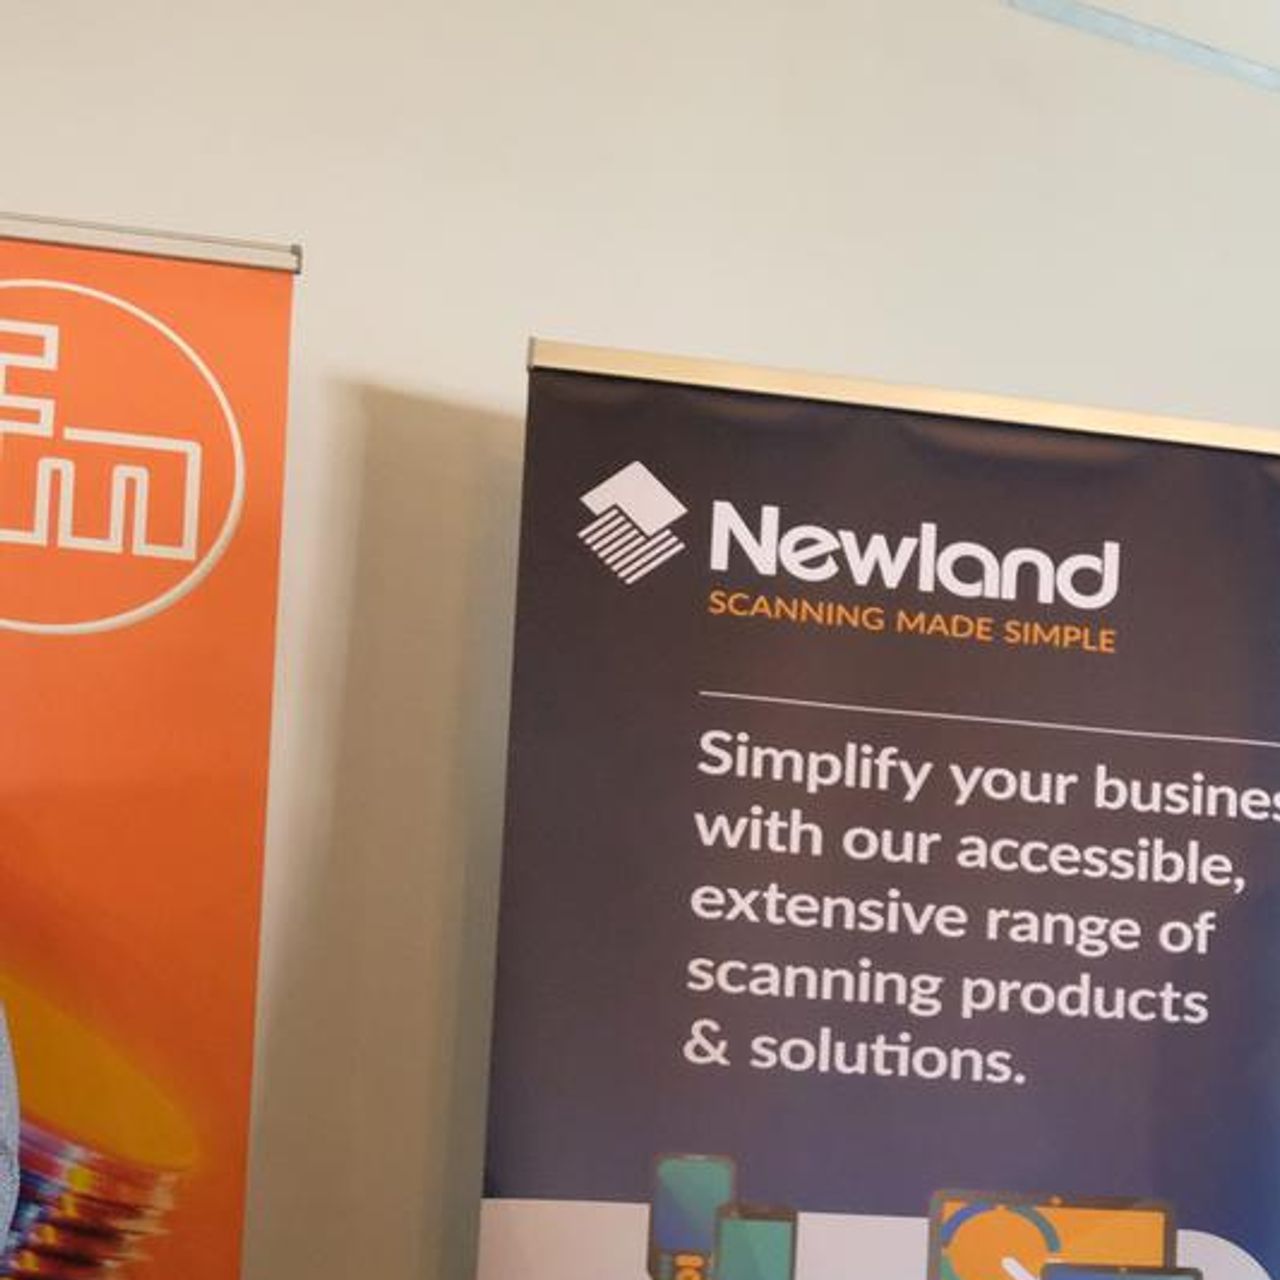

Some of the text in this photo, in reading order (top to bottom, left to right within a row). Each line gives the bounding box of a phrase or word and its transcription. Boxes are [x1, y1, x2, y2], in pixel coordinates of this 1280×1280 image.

[709, 499, 1121, 610] Newland
[708, 590, 1117, 655] SCANNING MADE SIMPLE
[698, 729, 933, 802] Simplify
[949, 763, 1078, 806] your
[694, 804, 1247, 895] with our accessible,
[690, 882, 1217, 958] extensive range of
[686, 956, 1209, 1025] scanning products
[683, 1018, 1026, 1085] & solutions.
